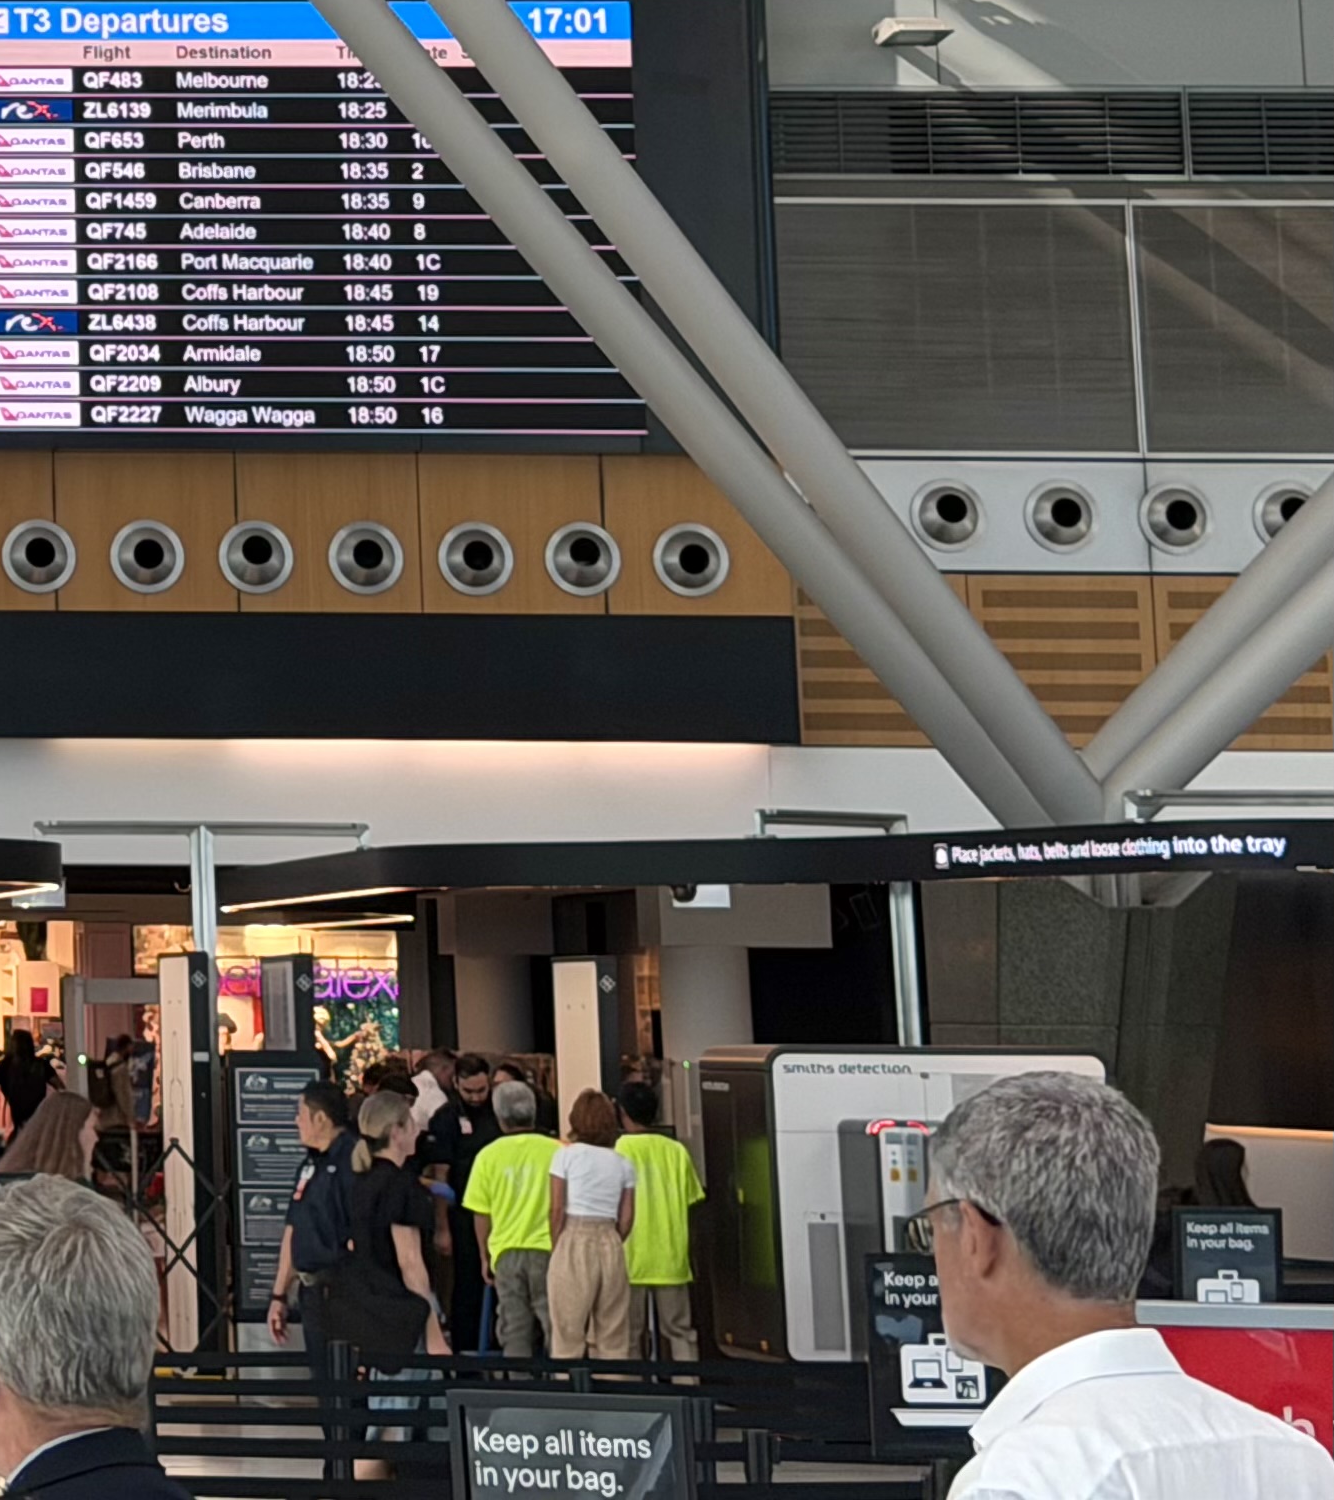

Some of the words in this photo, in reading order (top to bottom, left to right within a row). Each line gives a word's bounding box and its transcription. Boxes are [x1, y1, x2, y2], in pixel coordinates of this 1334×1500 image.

[14, 8, 51, 33] T3
[61, 8, 229, 40] Departures
[528, 8, 607, 33] 17:01
[83, 46, 131, 62] Flight
[176, 46, 272, 59] Destination
[83, 72, 143, 89] QF483
[176, 72, 269, 88] Melbourne
[83, 102, 151, 119] ZL6139
[177, 102, 268, 119] Merimbula
[338, 102, 387, 119] 18:25
[85, 132, 144, 149] QF653
[178, 132, 225, 149] Perth
[339, 132, 388, 149] 18:30
[85, 163, 145, 179] QF546
[179, 162, 256, 179] Brisbane
[340, 163, 389, 179] 18:35
[412, 163, 423, 179] 2
[86, 193, 156, 209] QF1459
[179, 193, 261, 209] Canberra
[341, 193, 390, 210] 18:35
[412, 193, 425, 210] 9
[86, 223, 146, 240] QF745
[180, 223, 256, 240] Adelaide
[342, 223, 391, 240] 18:40
[414, 223, 426, 240] 8
[87, 253, 158, 270] QF2166
[182, 253, 217, 270] Port
[222, 254, 314, 273] Macquarie
[343, 254, 391, 270] 18:40
[416, 254, 441, 270] 1C
[88, 284, 159, 300] QF2108
[182, 284, 227, 301] Coffs
[233, 284, 304, 301] Harbour
[344, 284, 393, 301] 18:45
[418, 284, 439, 301] 19
[88, 314, 156, 331] ZL6438
[182, 314, 228, 331] Coffs
[234, 314, 305, 331] Harbour
[345, 315, 394, 332] 18:45
[418, 315, 439, 331] 14
[90, 345, 161, 361] QF2034
[183, 345, 261, 361] Armidale
[346, 345, 395, 362] 18:50
[419, 345, 441, 362] 17
[90, 376, 161, 392] QF2209
[184, 376, 241, 395] Albury
[347, 376, 396, 393] 18:50
[420, 376, 445, 393] 1C
[91, 406, 162, 422] QF2227
[185, 406, 248, 426] Wagga
[252, 406, 315, 427] Wagga
[348, 407, 397, 424] 18:50
[421, 407, 443, 424] 16
[1172, 836, 1207, 854] into
[1210, 835, 1242, 853] the
[1245, 836, 1286, 857] tray
[783, 1064, 834, 1074] smiths
[838, 1064, 911, 1074] detection
[473, 1426, 539, 1459] Keep
[545, 1429, 574, 1456] all
[579, 1430, 652, 1459] items
[474, 1460, 498, 1486] in
[502, 1467, 561, 1493] your
[565, 1463, 624, 1498] bag.
